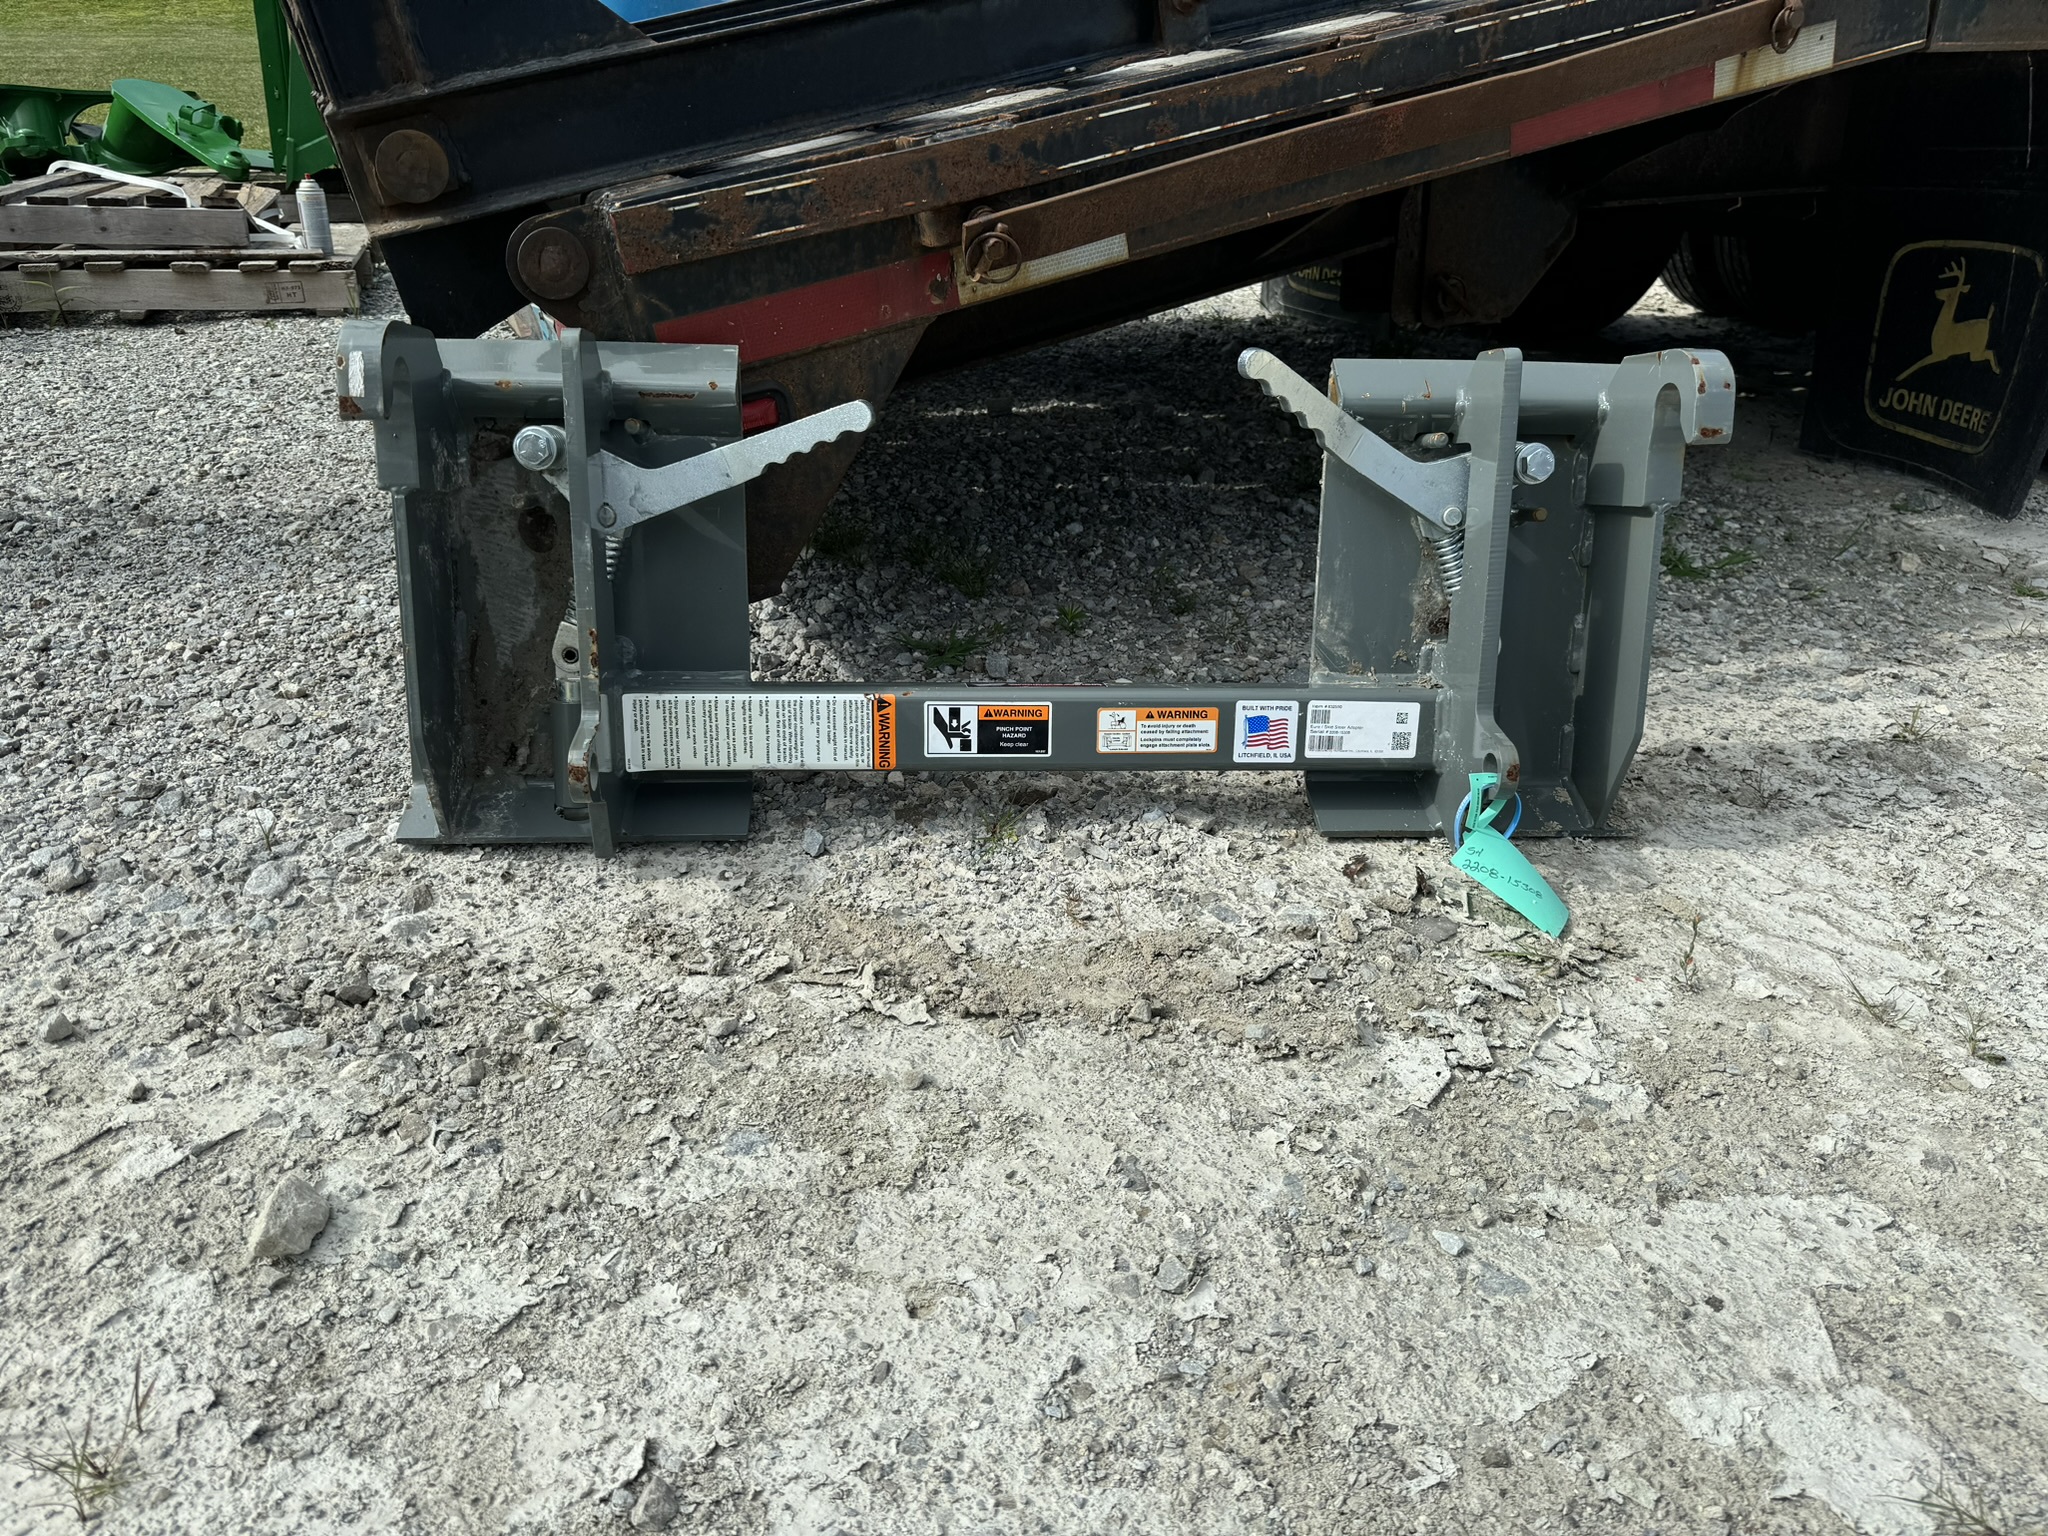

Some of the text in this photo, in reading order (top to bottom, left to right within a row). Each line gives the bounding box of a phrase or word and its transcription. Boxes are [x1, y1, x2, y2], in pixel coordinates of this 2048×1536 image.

[1879, 387, 1992, 434] JOHN DEERE
[993, 709, 1042, 717] WARNING
[1157, 710, 1208, 719] WARNING
[879, 713, 890, 768] WARNING
[1462, 859, 1543, 899] 2208-15308
